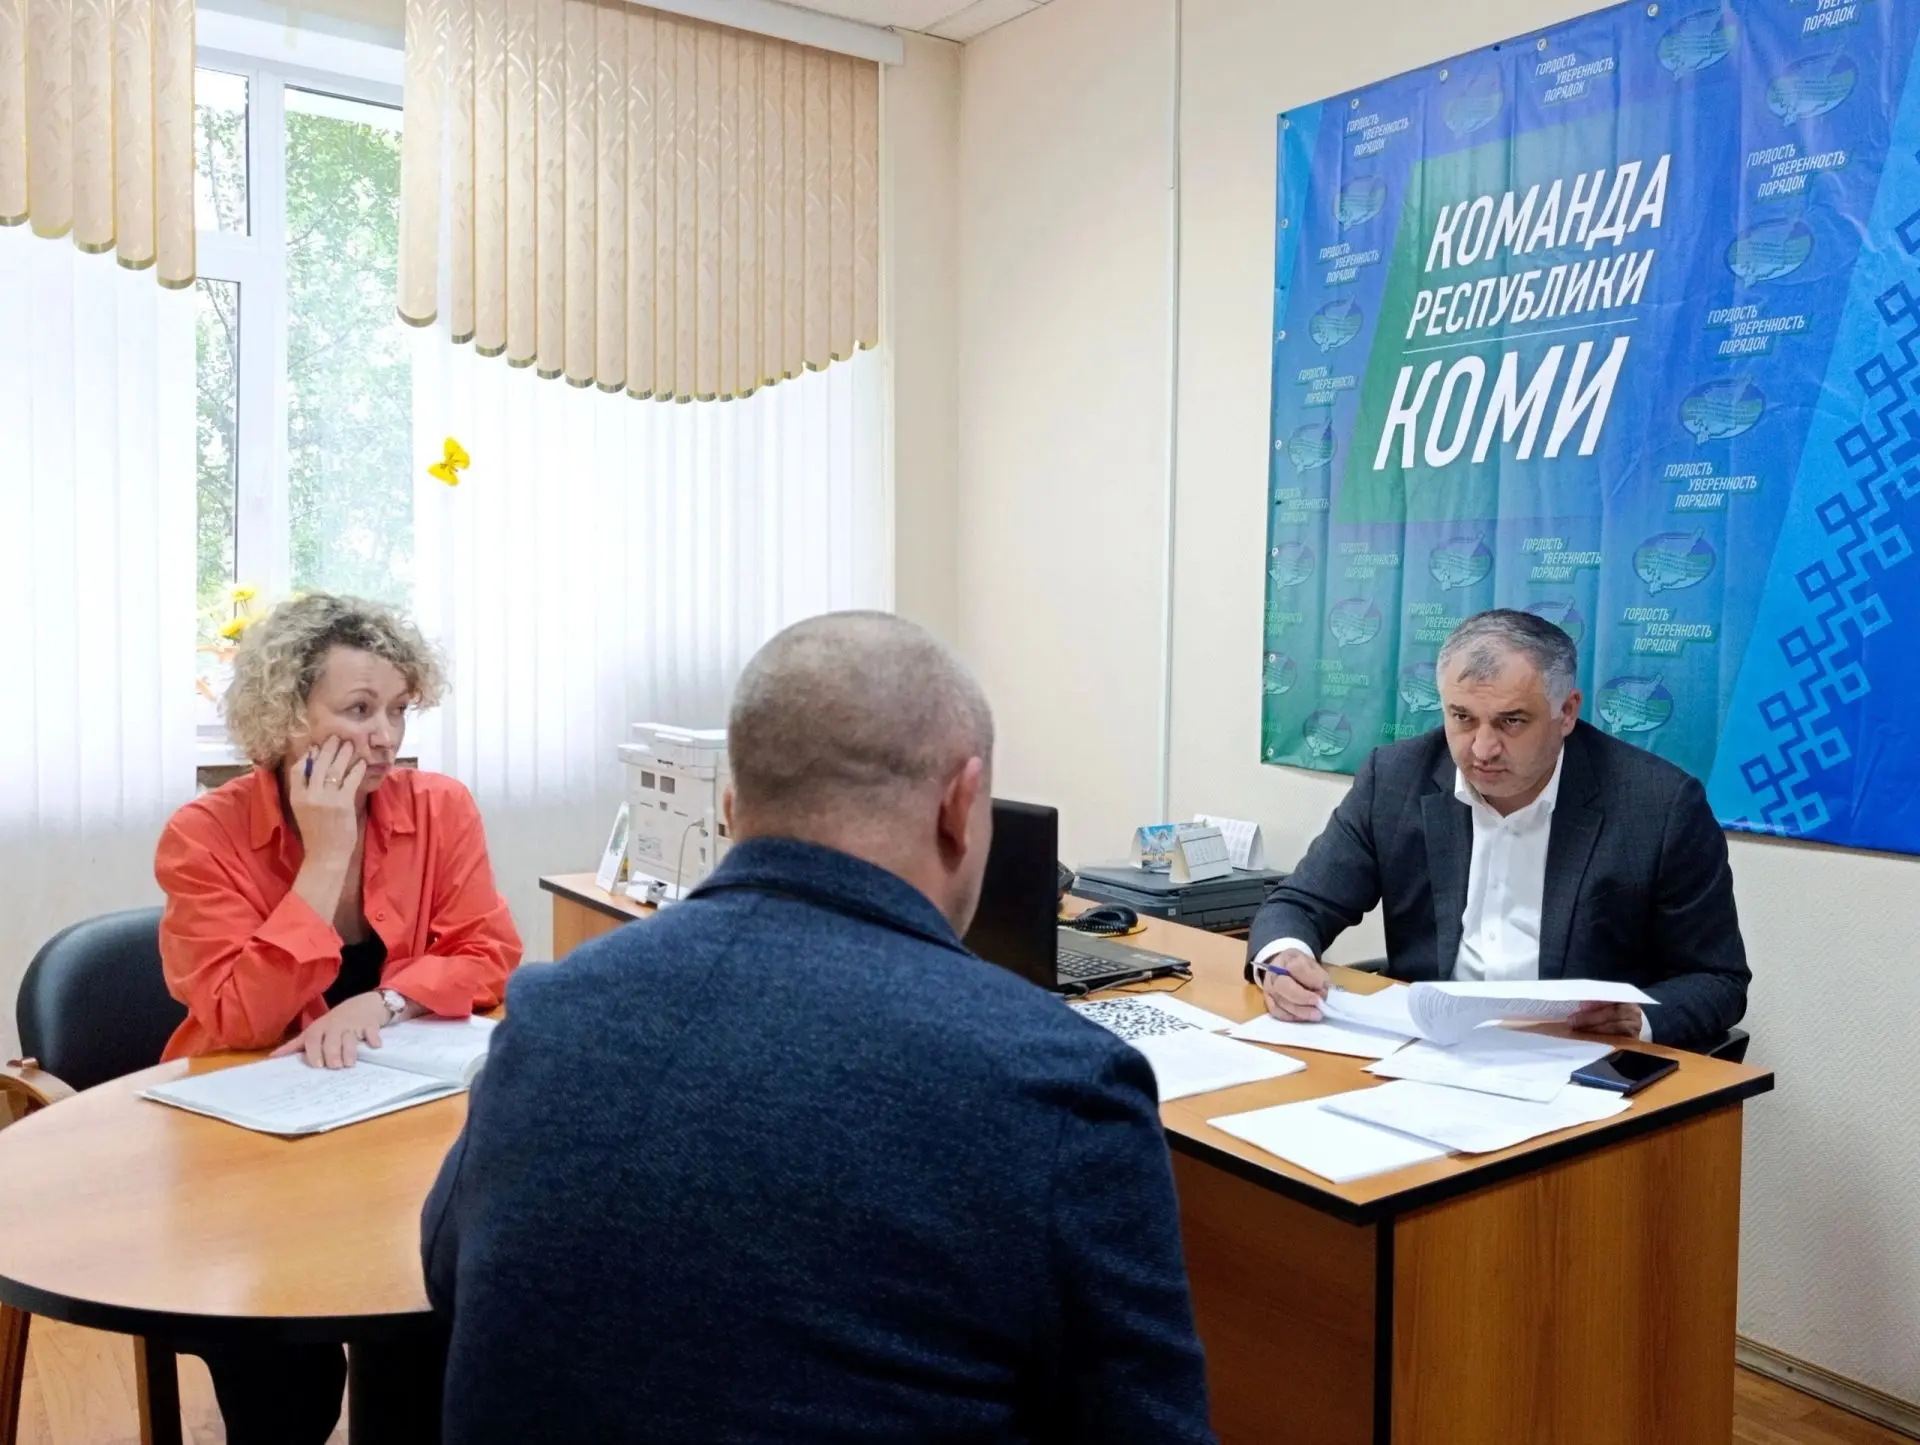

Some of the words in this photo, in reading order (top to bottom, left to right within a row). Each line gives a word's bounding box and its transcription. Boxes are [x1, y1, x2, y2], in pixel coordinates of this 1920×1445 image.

[1803, 4, 1857, 33] ПОРЯДОК
[1535, 52, 1576, 78] ГОРДОСТЬ
[1556, 57, 1614, 86] УВЕРЕННОСТЬ
[1544, 80, 1586, 103] ПОРЯДОК
[1746, 144, 1796, 168] ГОРДОСТЬ
[1771, 150, 1846, 178] УВЕРЕННОСТЬ
[1757, 174, 1808, 197] ПОРЯДОК
[1424, 154, 1671, 273] КОМАНДА
[1405, 249, 1655, 340] РЕСПУБЛИКИ
[1707, 305, 1758, 324] ГОРДОСТЬ
[1732, 315, 1805, 338] УВЕРЕННОСТЬ
[1718, 336, 1769, 355] ПОРЯДОК
[1373, 336, 1631, 471] КОМИ
[1664, 462, 1713, 478] ГОРДОСТЬ
[1688, 475, 1757, 492] УВЕРЕННОСТЬ
[1674, 493, 1725, 508] ПОРЯДОК
[1522, 537, 1563, 553] ГОРДОСТЬ
[1541, 552, 1602, 565] УВЕРЕННОСТЬ
[1530, 566, 1573, 580] ПОРЯДОК
[1623, 607, 1670, 622] ГОРДОСТЬ
[1644, 622, 1713, 638] УВЕРЕННОСТЬ
[1633, 638, 1680, 653] ПОРЯДОК
